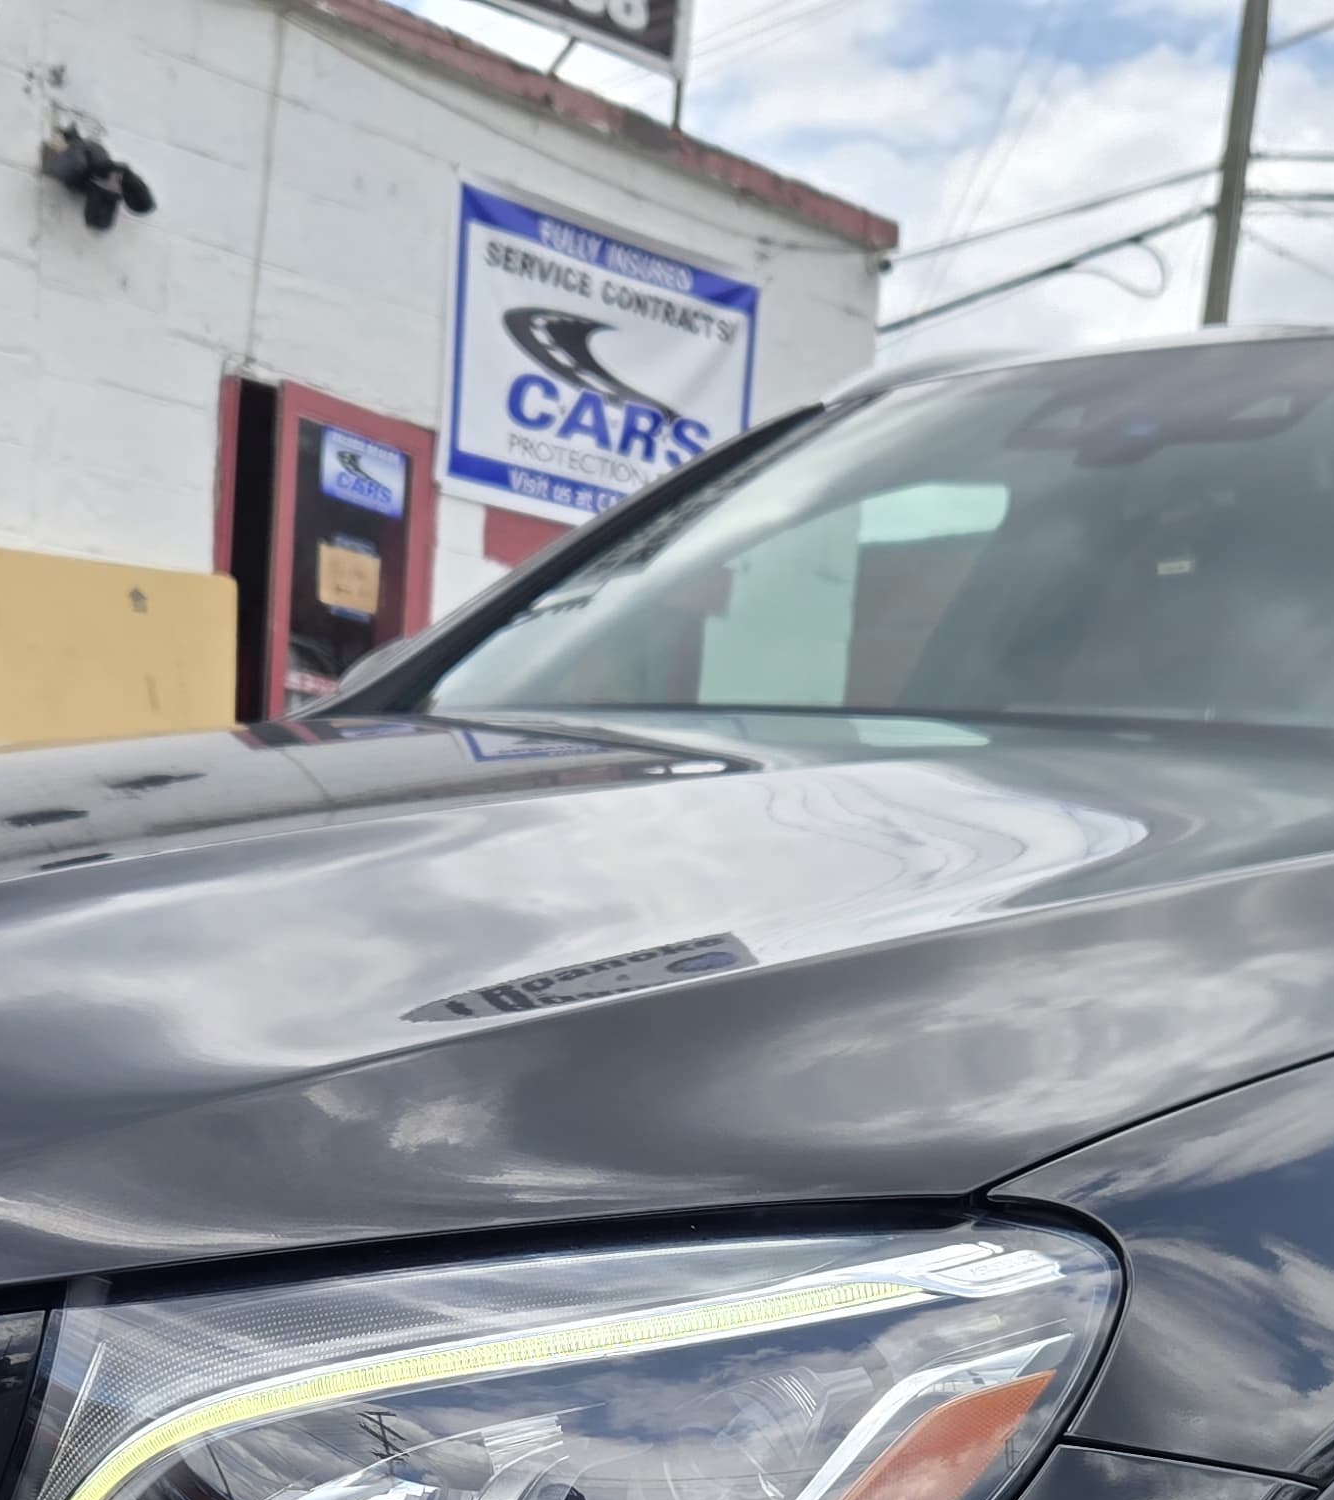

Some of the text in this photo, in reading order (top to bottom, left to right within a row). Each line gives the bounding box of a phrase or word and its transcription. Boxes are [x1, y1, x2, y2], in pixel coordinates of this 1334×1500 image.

[483, 240, 593, 298] SERVICE
[538, 218, 695, 292] FULLY INSURED
[506, 372, 711, 468] CARS
[334, 470, 393, 504] CARS
[507, 433, 652, 488] PROTECTION
[508, 466, 549, 499] Visit
